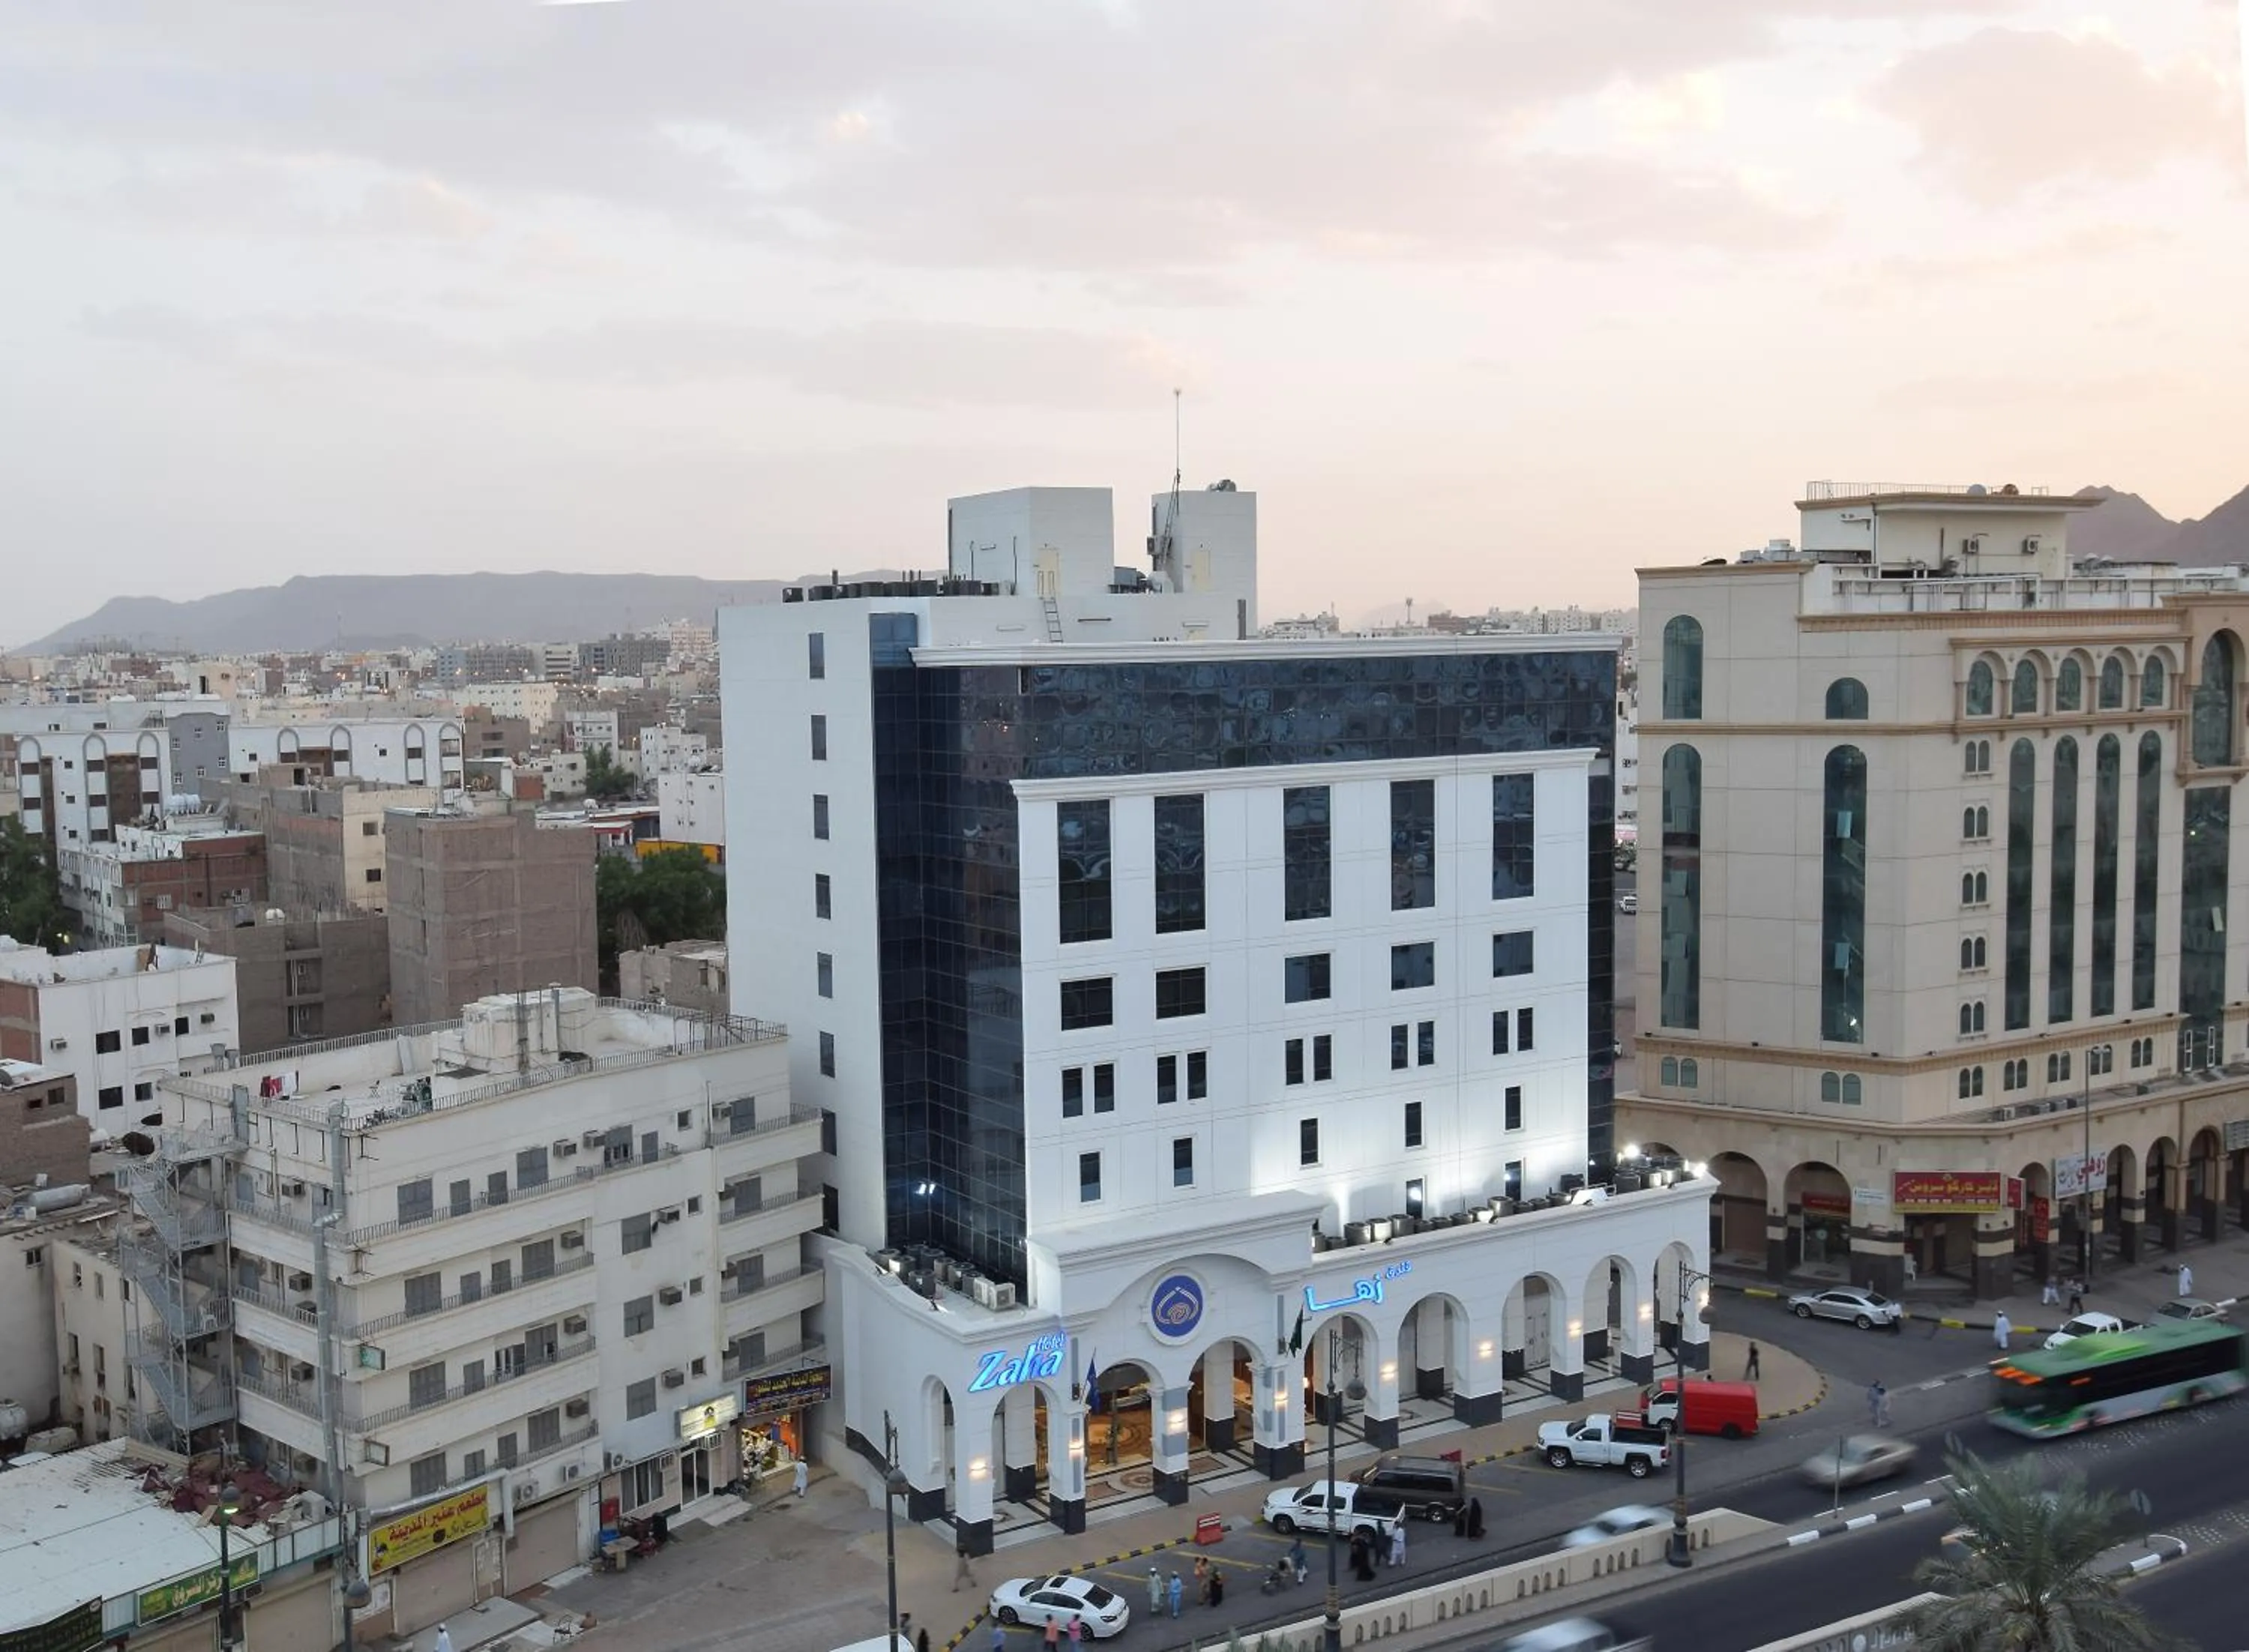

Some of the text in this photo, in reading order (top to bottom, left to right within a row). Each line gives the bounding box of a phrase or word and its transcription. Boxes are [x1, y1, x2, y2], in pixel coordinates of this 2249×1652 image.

[1385, 1260, 1412, 1279] فندق
[968, 1330, 1066, 1393] Zaha Hotel
